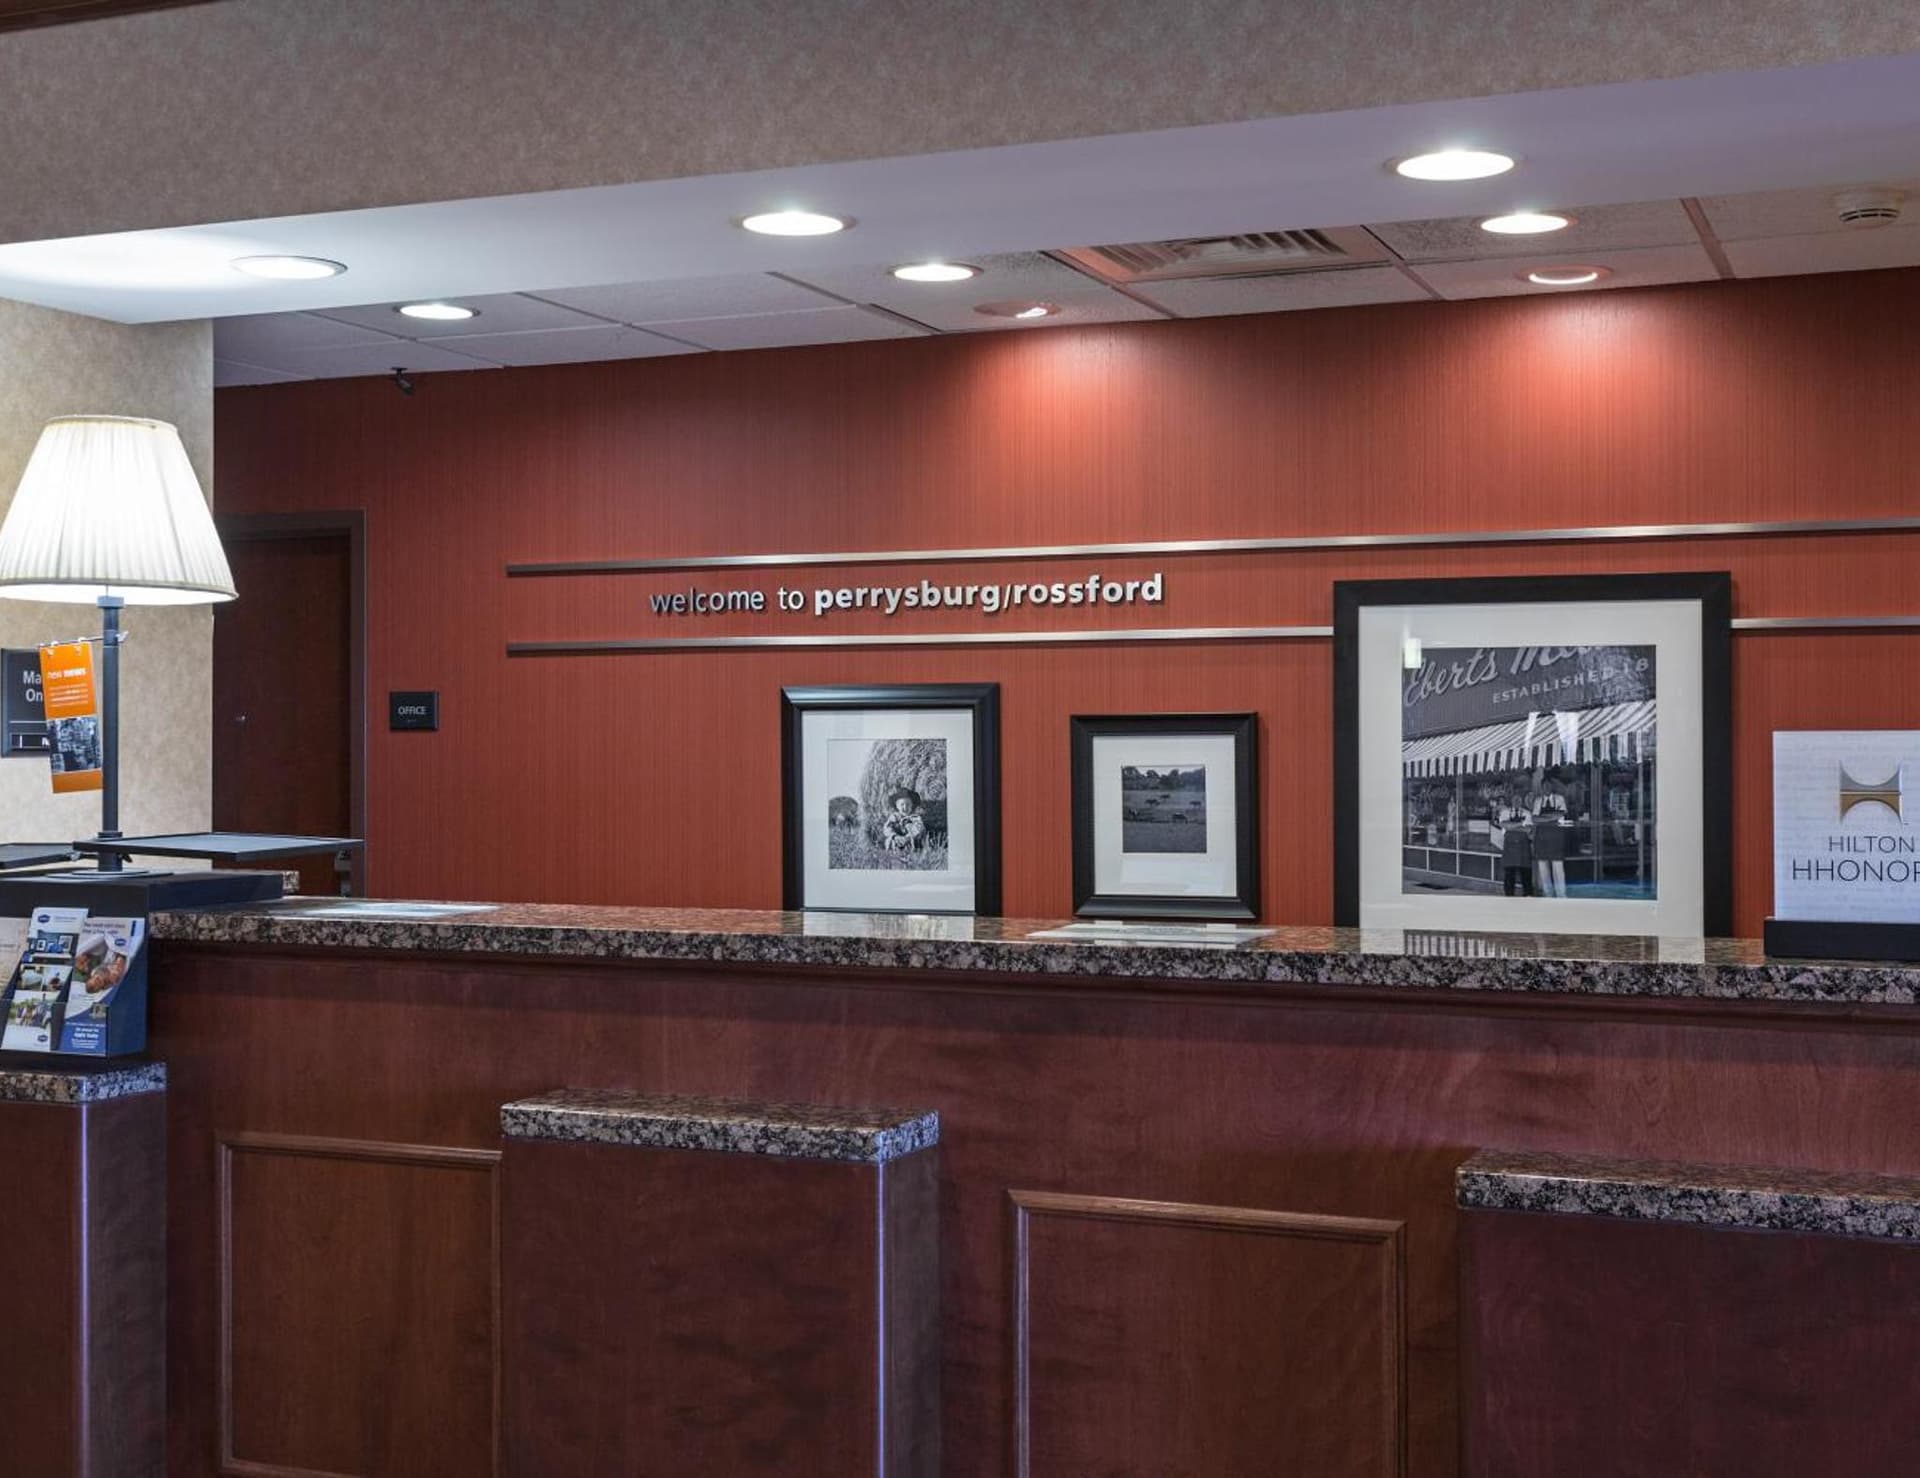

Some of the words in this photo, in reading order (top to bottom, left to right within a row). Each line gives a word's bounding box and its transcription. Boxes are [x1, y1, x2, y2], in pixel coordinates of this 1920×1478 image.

[650, 587, 765, 613] welcome
[777, 586, 804, 610] to
[814, 573, 1163, 616] perrysburg/rossford
[1493, 666, 1614, 703] ESTABLISHED
[398, 705, 426, 715] OFFICE
[1828, 835, 1914, 853] HILTON
